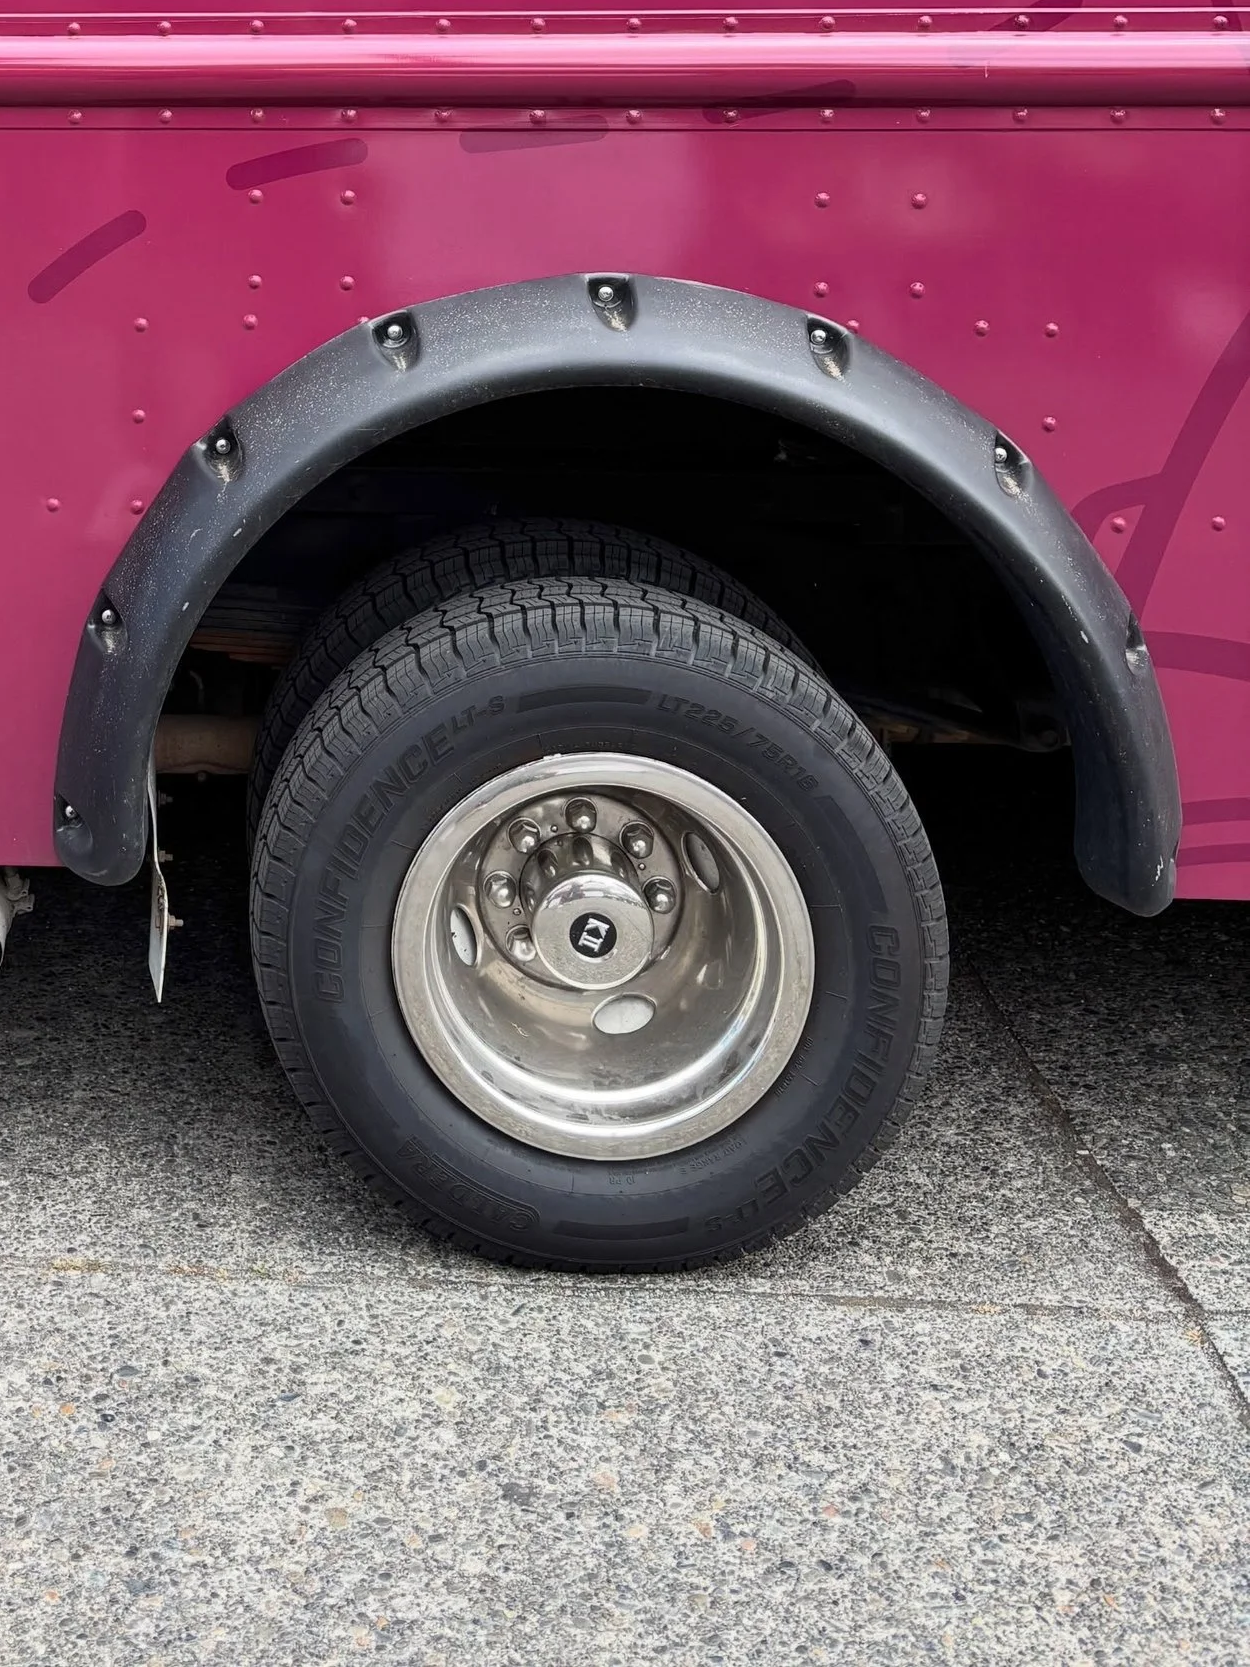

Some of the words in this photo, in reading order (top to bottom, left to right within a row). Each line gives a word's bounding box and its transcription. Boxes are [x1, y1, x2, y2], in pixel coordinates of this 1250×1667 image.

[314, 736, 456, 1002] CONFIDENCE
[452, 694, 505, 731] LT-S
[656, 691, 820, 793] LT225/75R16
[753, 924, 901, 1206] CONFIDENCE
